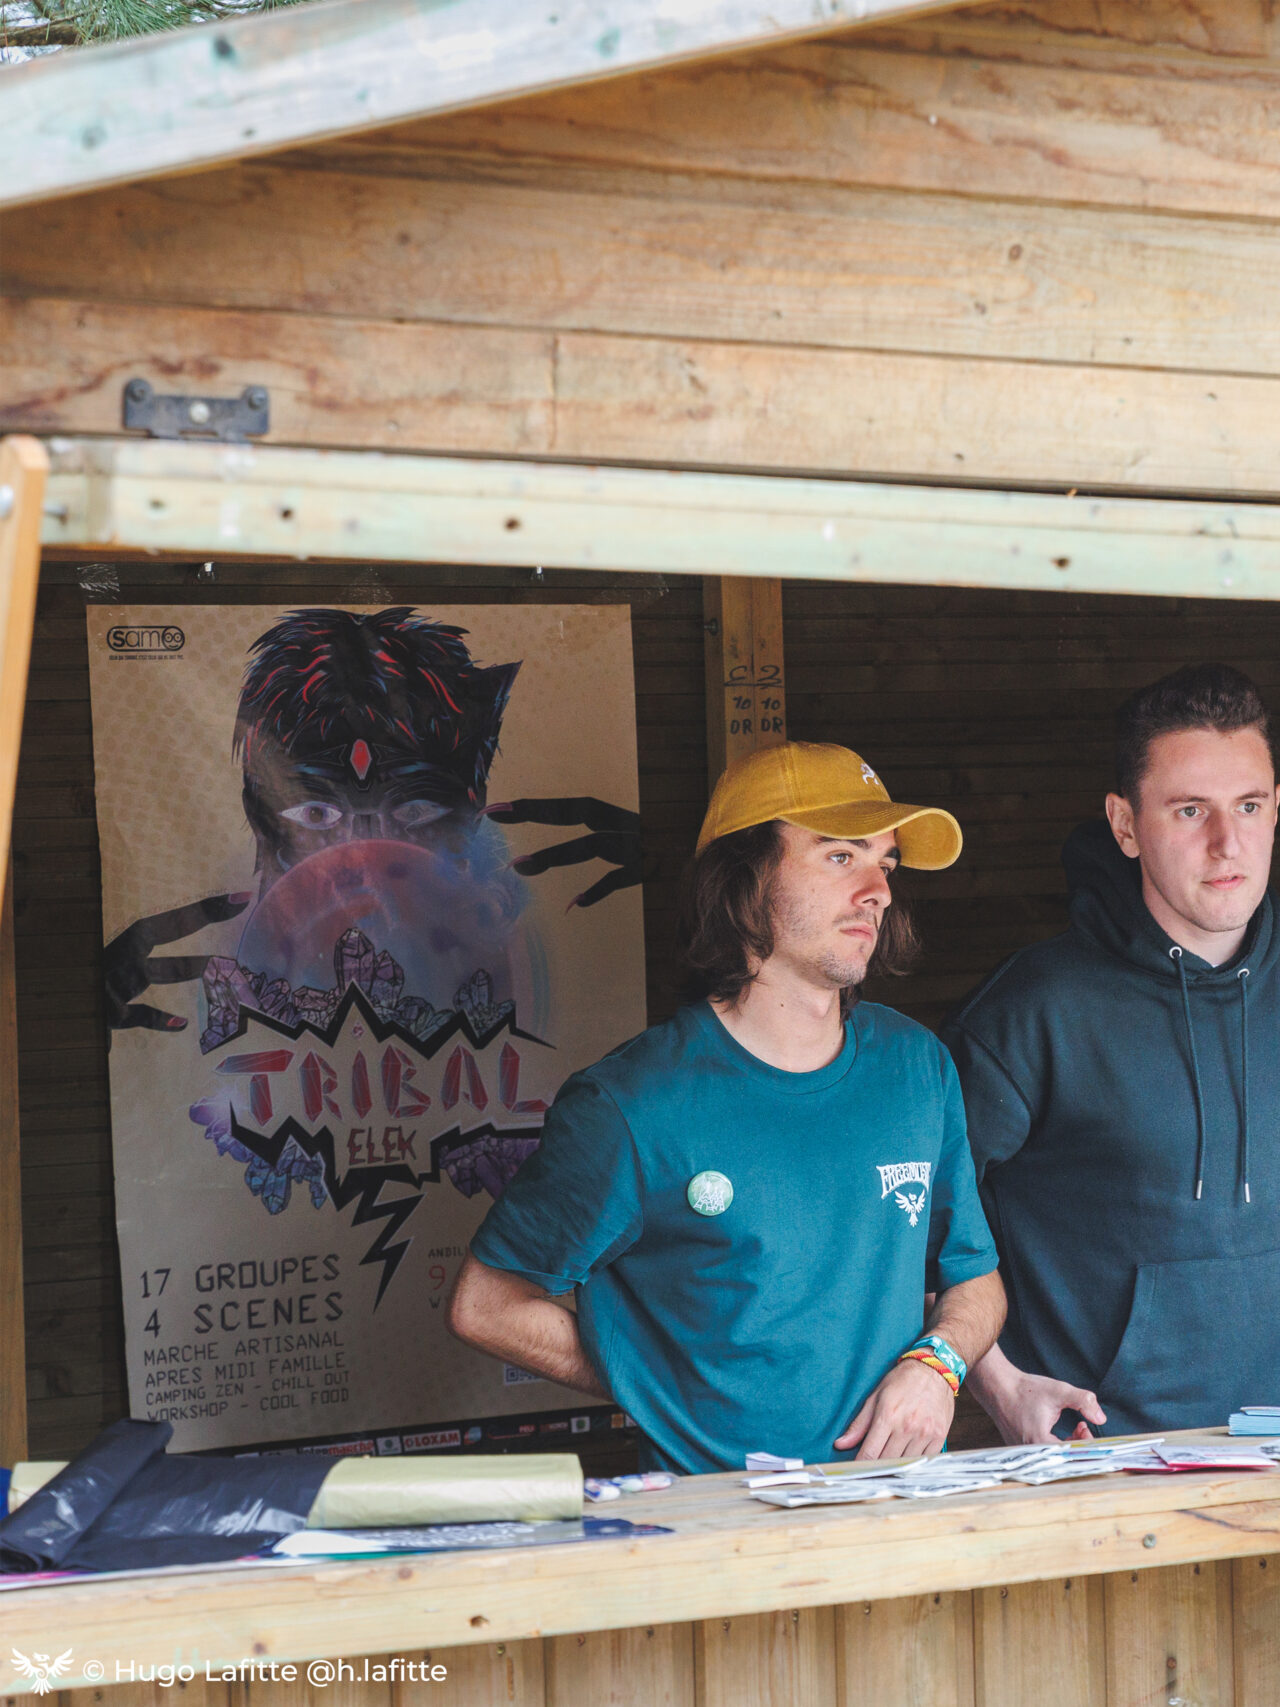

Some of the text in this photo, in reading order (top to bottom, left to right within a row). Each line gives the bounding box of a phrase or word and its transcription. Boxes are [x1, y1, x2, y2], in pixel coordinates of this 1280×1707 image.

[214, 1041, 550, 1127] TRIBAL
[347, 1126, 417, 1165] ELEK
[428, 1246, 464, 1259] ANDIL
[140, 1253, 340, 1298] 17 GROUPES
[428, 1264, 446, 1290] 9
[144, 1291, 344, 1339] 4 SCENES
[144, 1331, 345, 1366] MARCHE ARTISANAL
[145, 1352, 345, 1388] APRES MIDI FAMILLE
[145, 1386, 206, 1406] CAMPING
[216, 1383, 245, 1398] ZEN
[272, 1376, 314, 1392] CHILL
[324, 1370, 350, 1387] OUT
[147, 1401, 229, 1422] WORKSHOP
[260, 1394, 299, 1411] COOL
[311, 1388, 350, 1405] FOOD
[414, 1431, 460, 1447] LOXAM
